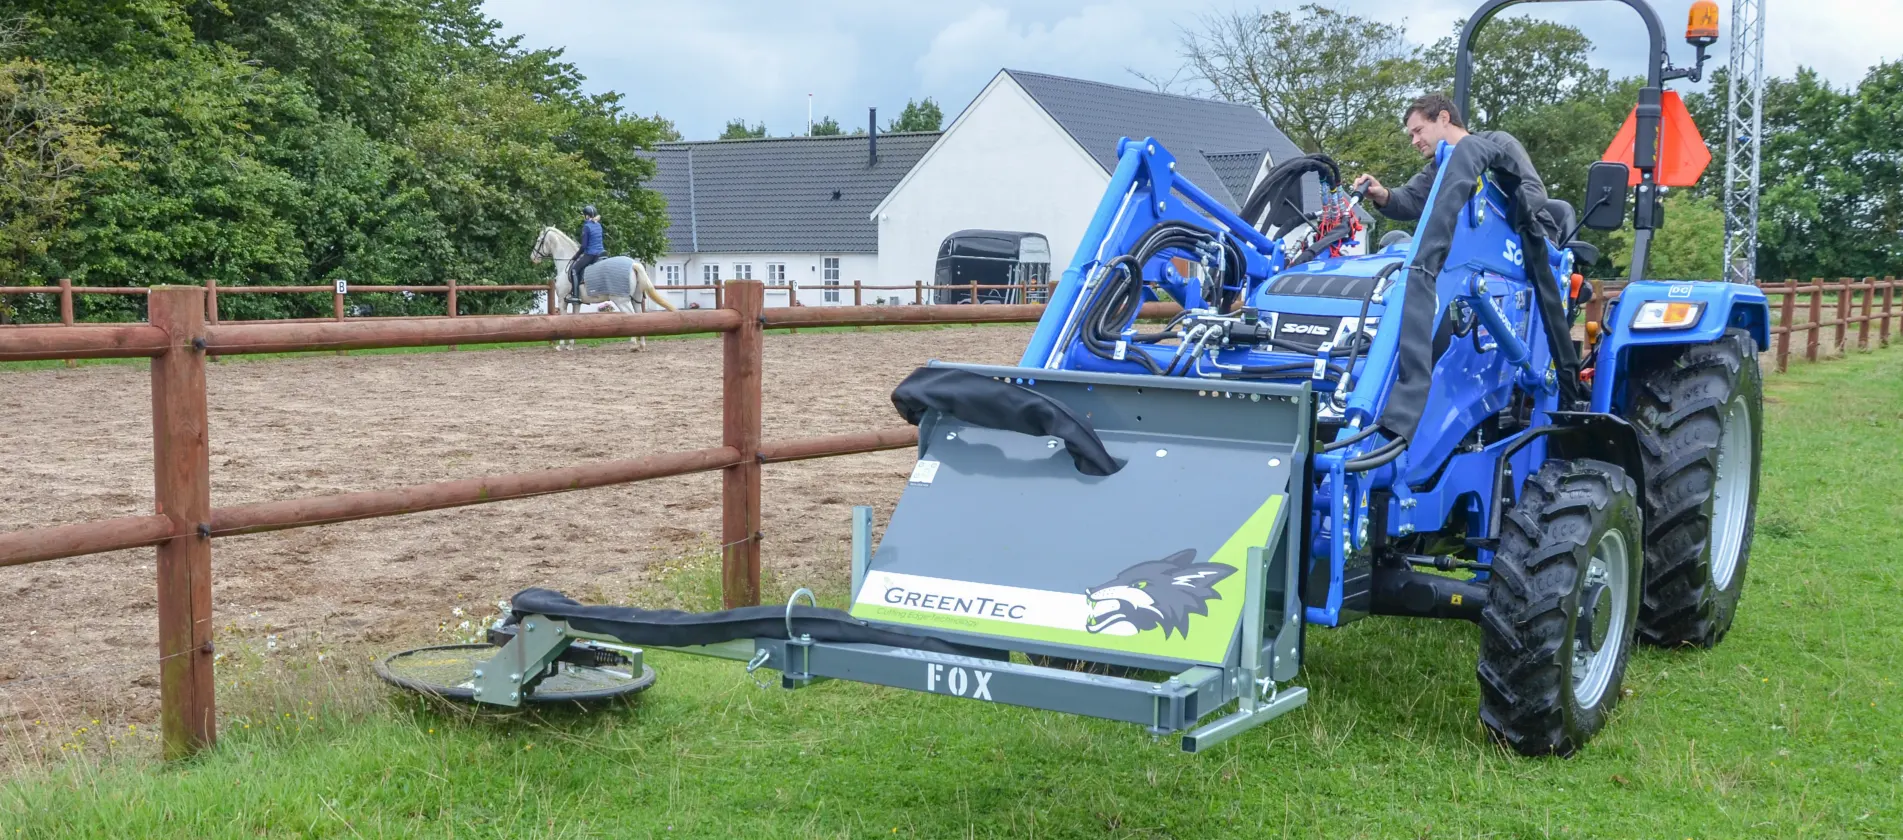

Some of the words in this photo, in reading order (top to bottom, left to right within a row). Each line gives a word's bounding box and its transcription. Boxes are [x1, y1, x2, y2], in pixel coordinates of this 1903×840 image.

[339, 281, 345, 292] B
[1672, 286, 1690, 294] DC
[877, 607, 906, 619] Cutting
[928, 663, 993, 701] FOX
